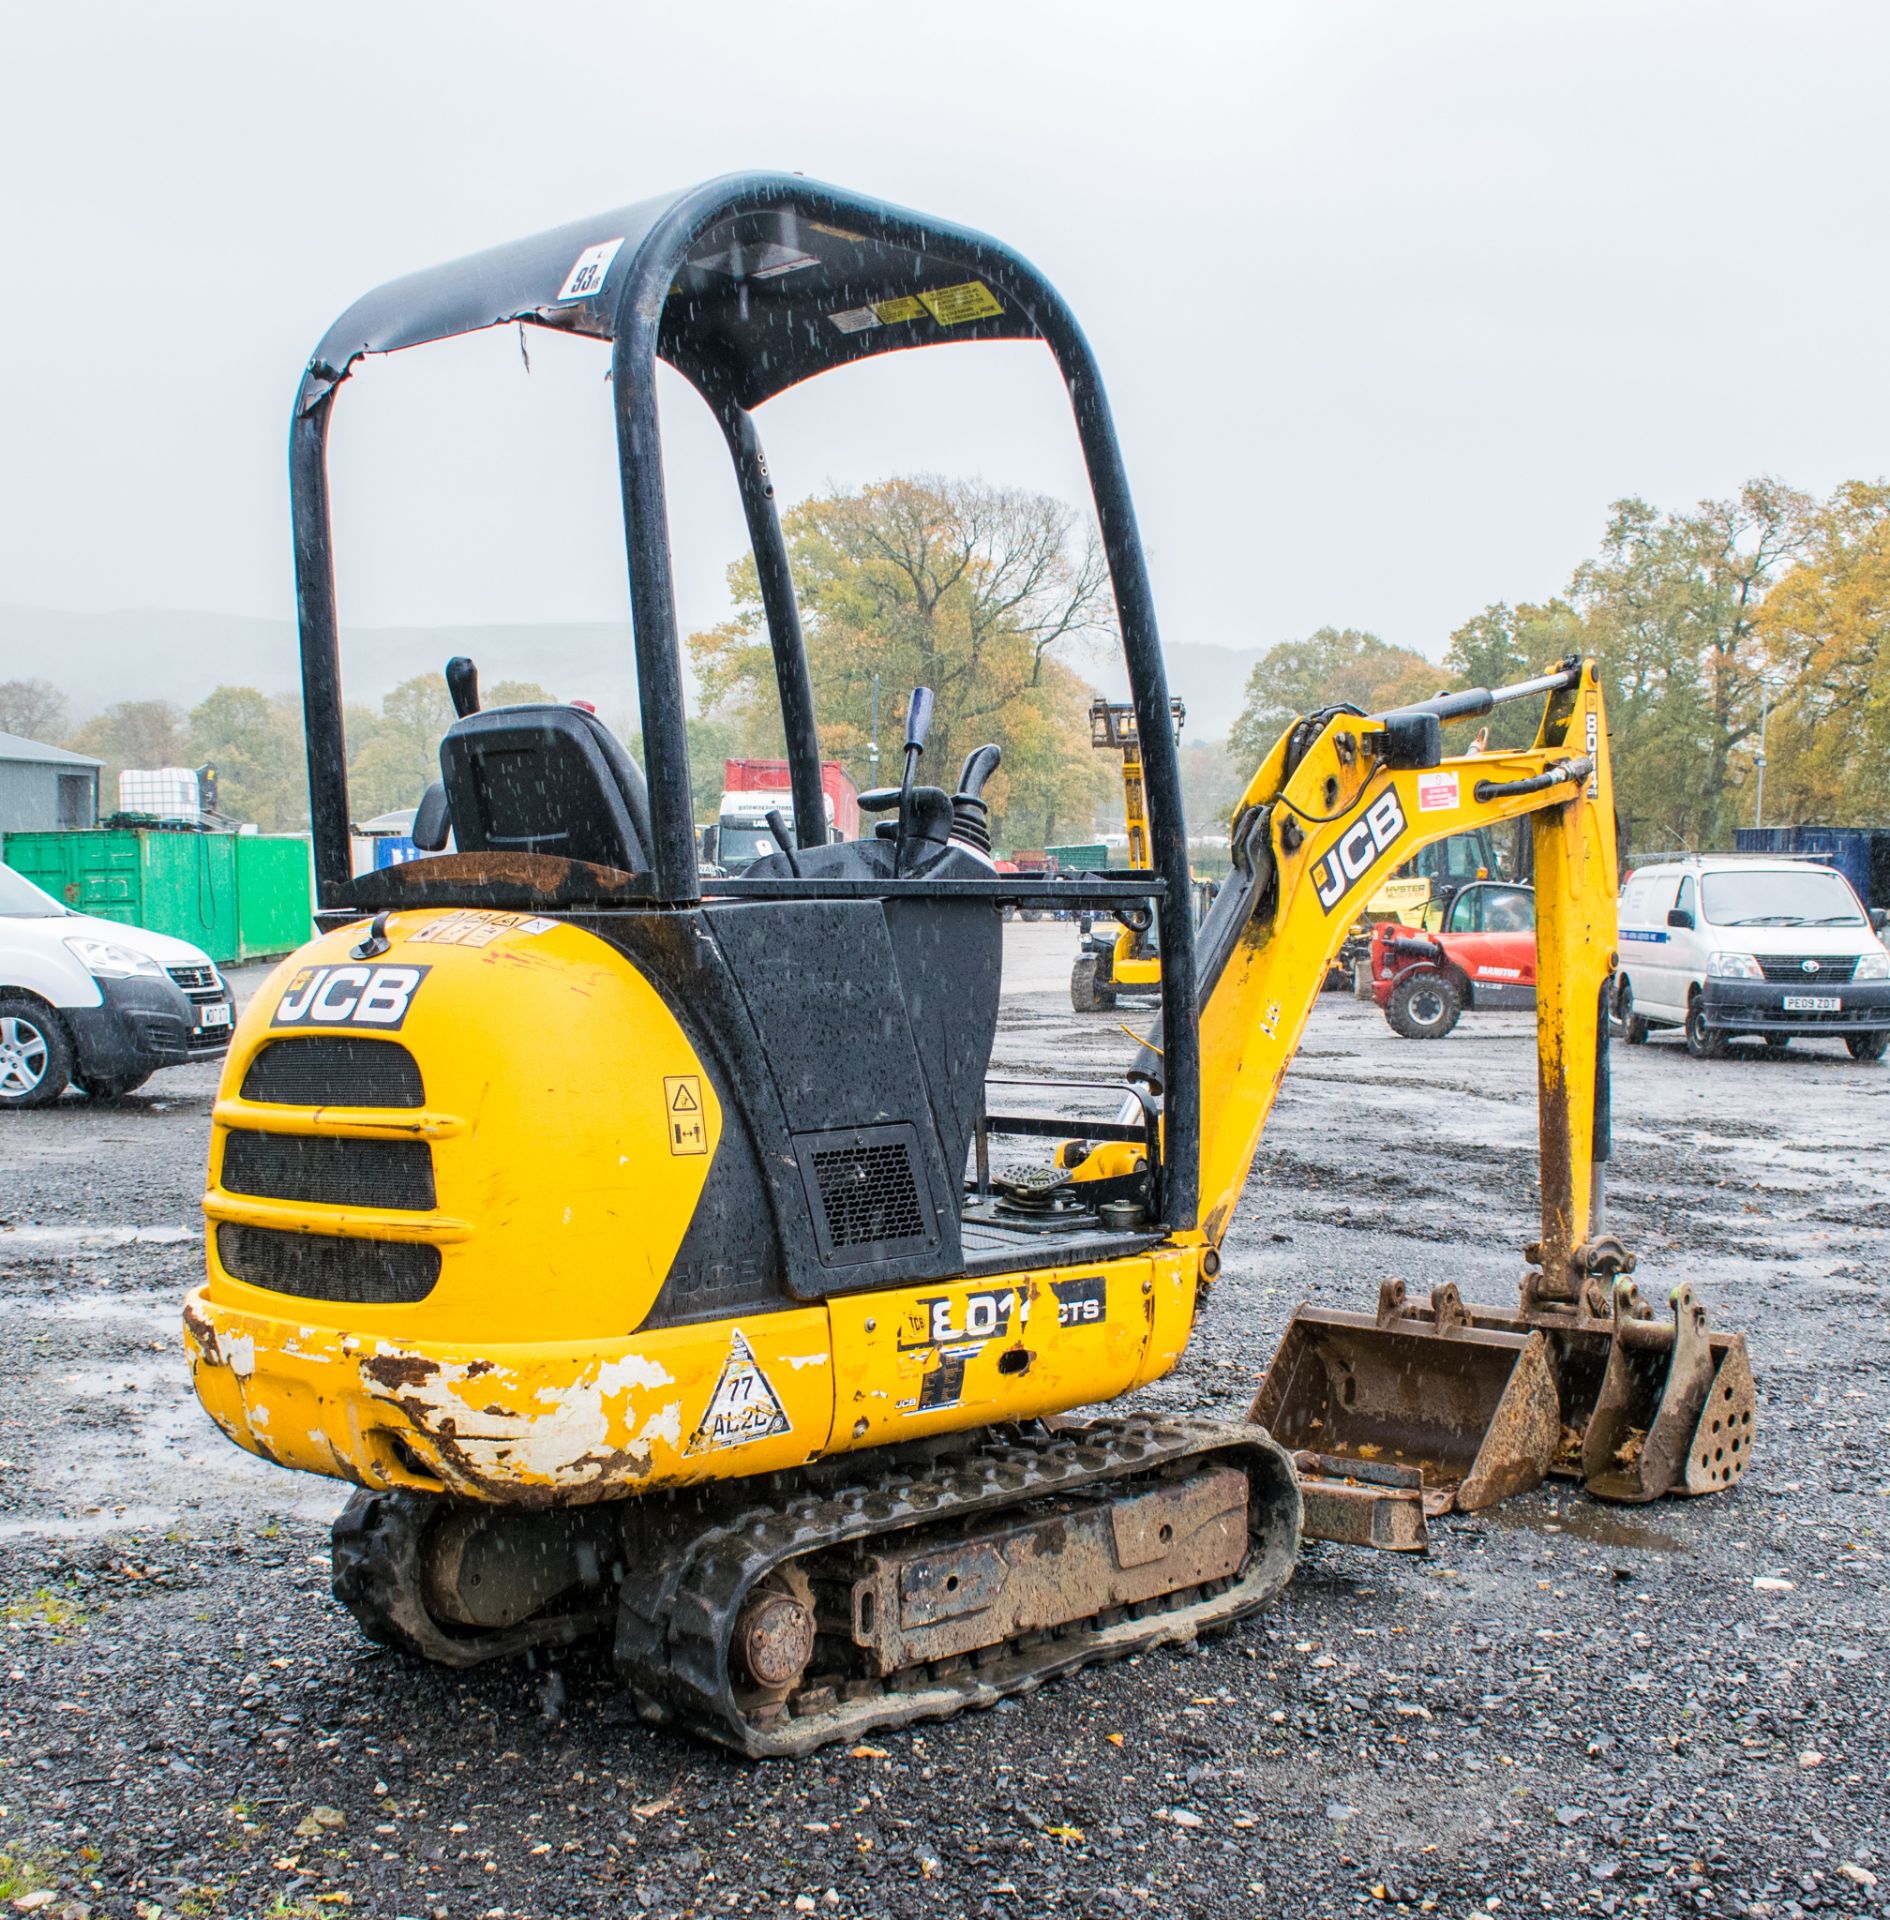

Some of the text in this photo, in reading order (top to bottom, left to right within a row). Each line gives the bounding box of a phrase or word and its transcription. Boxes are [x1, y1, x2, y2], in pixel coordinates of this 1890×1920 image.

[1319, 791, 1404, 907] JCB
[1385, 885, 1425, 893] HYSTER
[1477, 965, 1521, 978] MANITOU
[276, 966, 421, 1023] JCB
[1787, 998, 1815, 1009] PE09
[729, 1374, 754, 1402] 77
